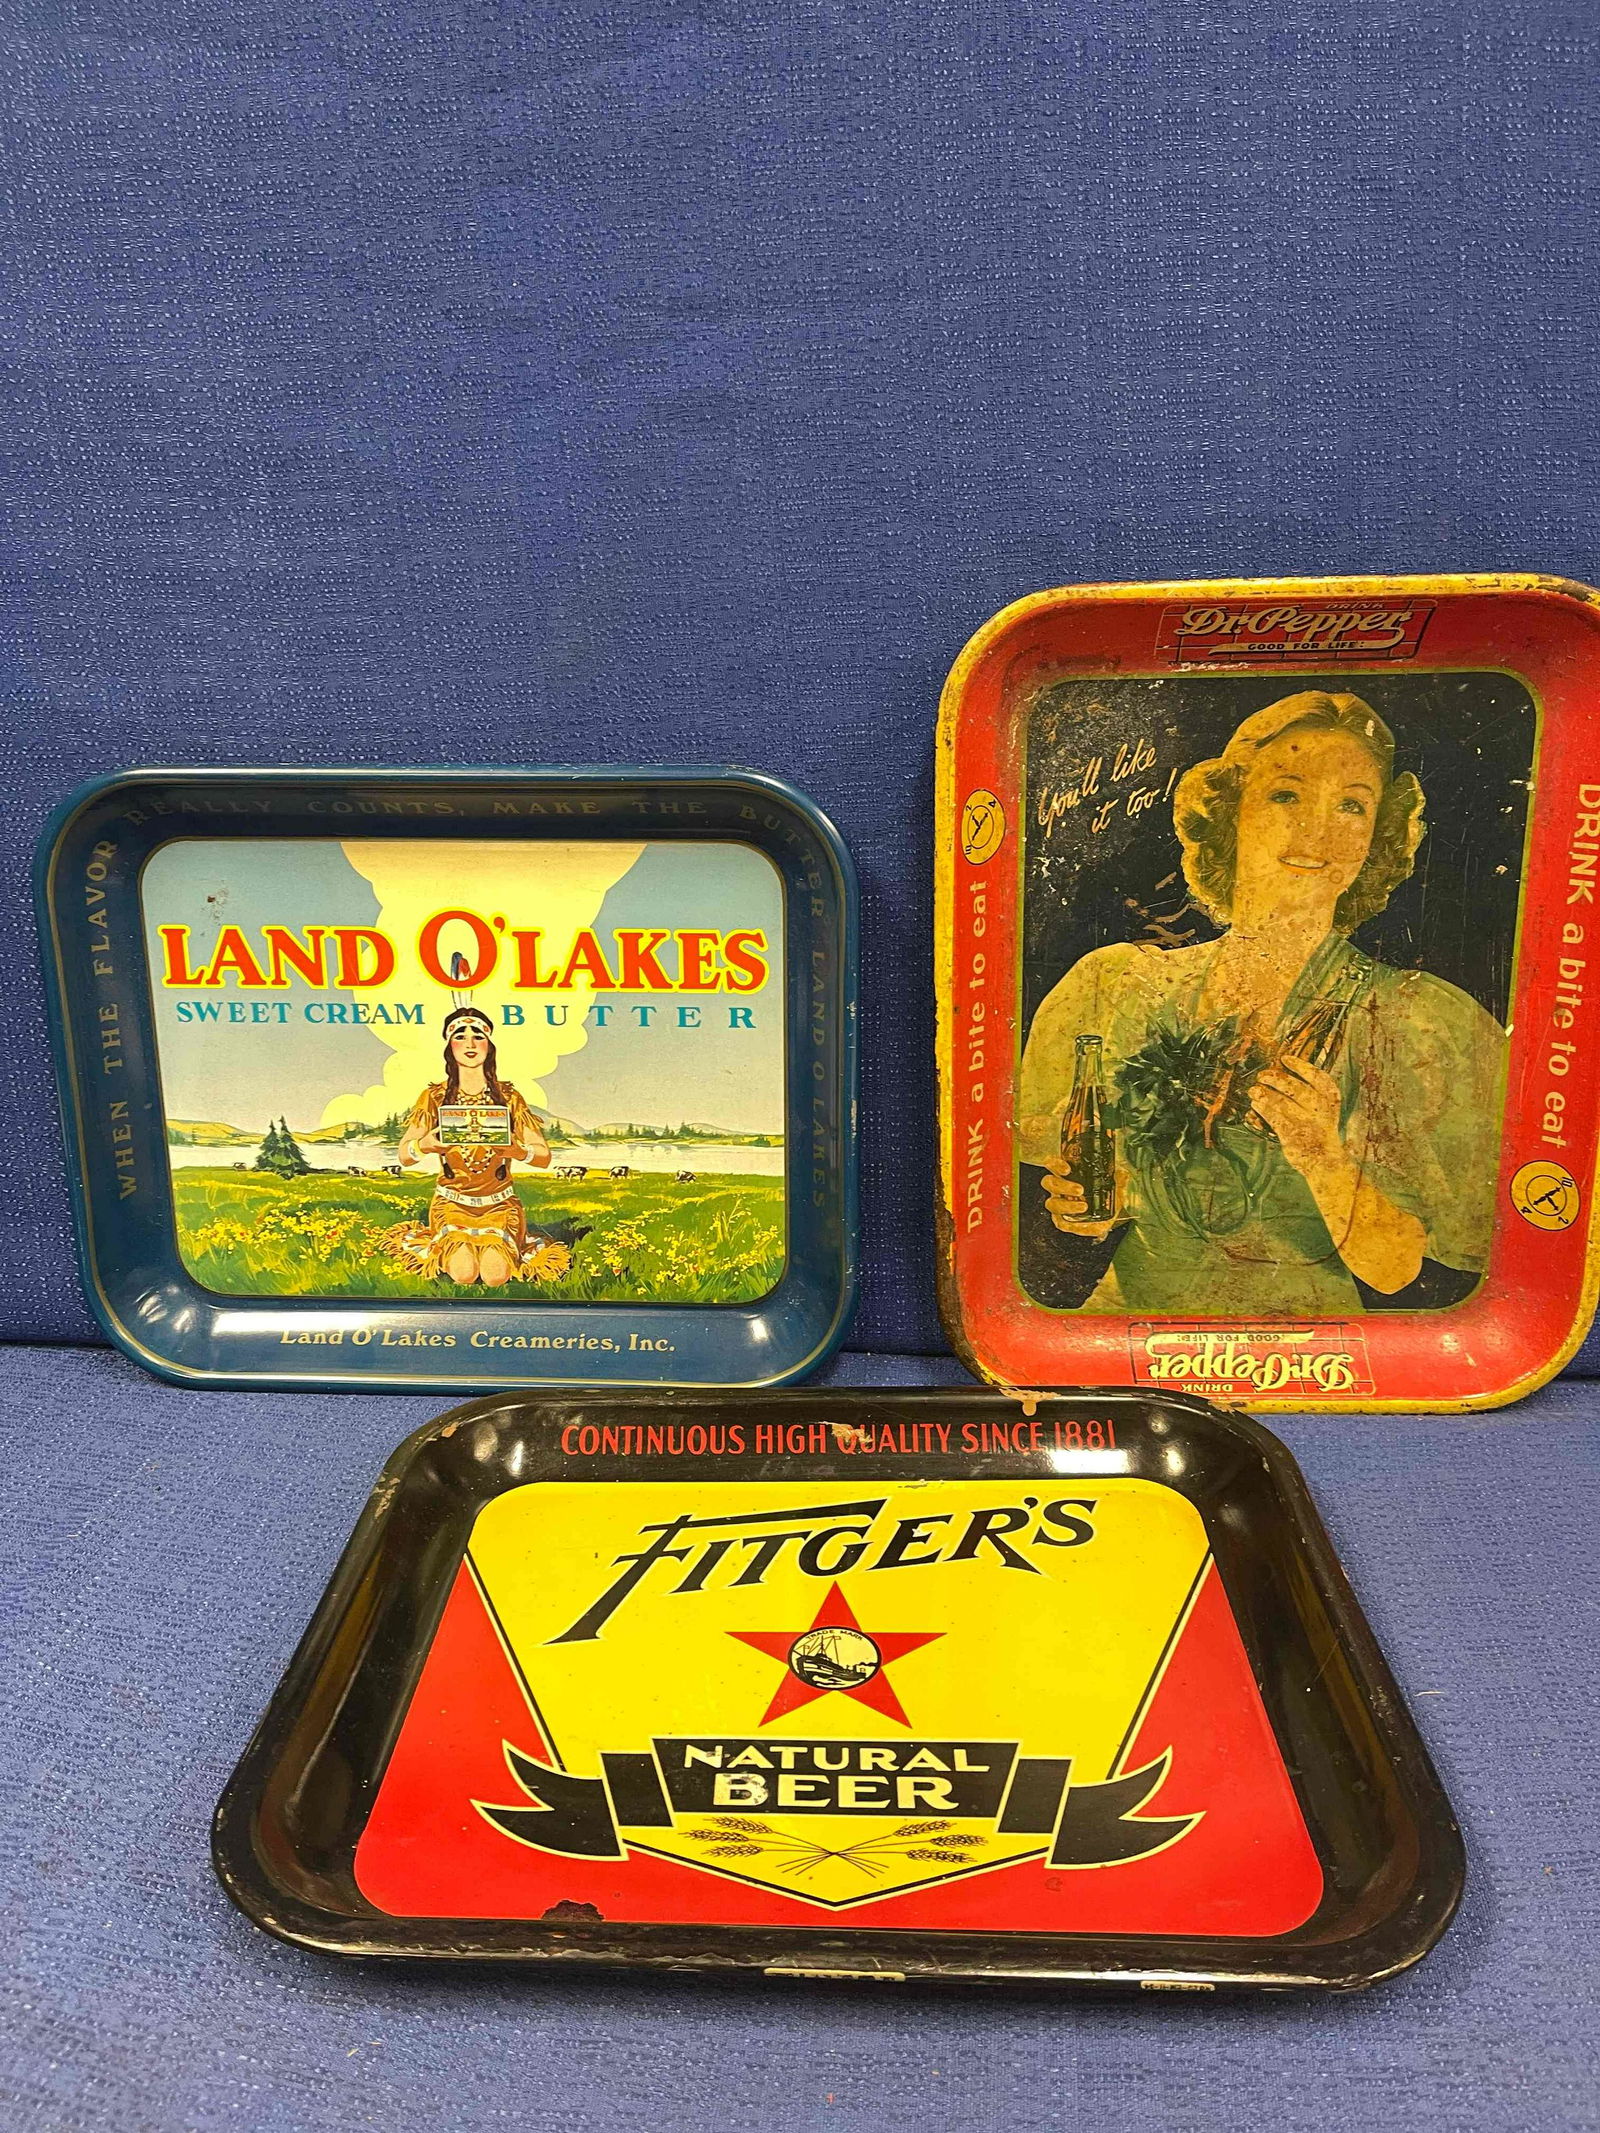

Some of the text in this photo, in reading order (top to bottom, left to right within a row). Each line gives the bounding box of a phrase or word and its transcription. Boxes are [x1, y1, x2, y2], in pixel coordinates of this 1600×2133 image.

[1247, 642, 1285, 651] GOOD
[1293, 641, 1319, 650] FOR
[1110, 738, 1157, 782] like
[123, 799, 272, 827] REALLY
[308, 801, 466, 817] COUNTS,
[494, 801, 601, 815] MAKE
[632, 801, 707, 815] THE
[1092, 799, 1119, 833] it
[739, 804, 826, 918] BUTTER
[85, 840, 119, 977] FLAVOR
[159, 908, 769, 993] LAND O'LAKES
[1540, 783, 1600, 1148] DRINK a bite to eat
[177, 1001, 758, 1030] SWEET CREAM BUTTER
[812, 950, 826, 1046] LAND
[100, 1003, 124, 1074] THE
[967, 880, 988, 1233] DRINK a bite to eat
[106, 1101, 137, 1199] WHEN
[812, 1099, 826, 1209] LAKES
[280, 1329, 344, 1346] Land
[471, 1330, 622, 1353] Creameries,
[628, 1333, 676, 1352] Inc.
[1181, 1383, 1233, 1392] DRINK
[561, 1419, 1117, 1456] CONTINUOUS HIGH QUALITY SINCE 1881
[545, 1496, 1097, 1645] FITGER'S
[806, 1629, 863, 1640] TRADE MARK
[684, 1743, 990, 1773] NATURAL
[713, 1773, 960, 1810] BEER
